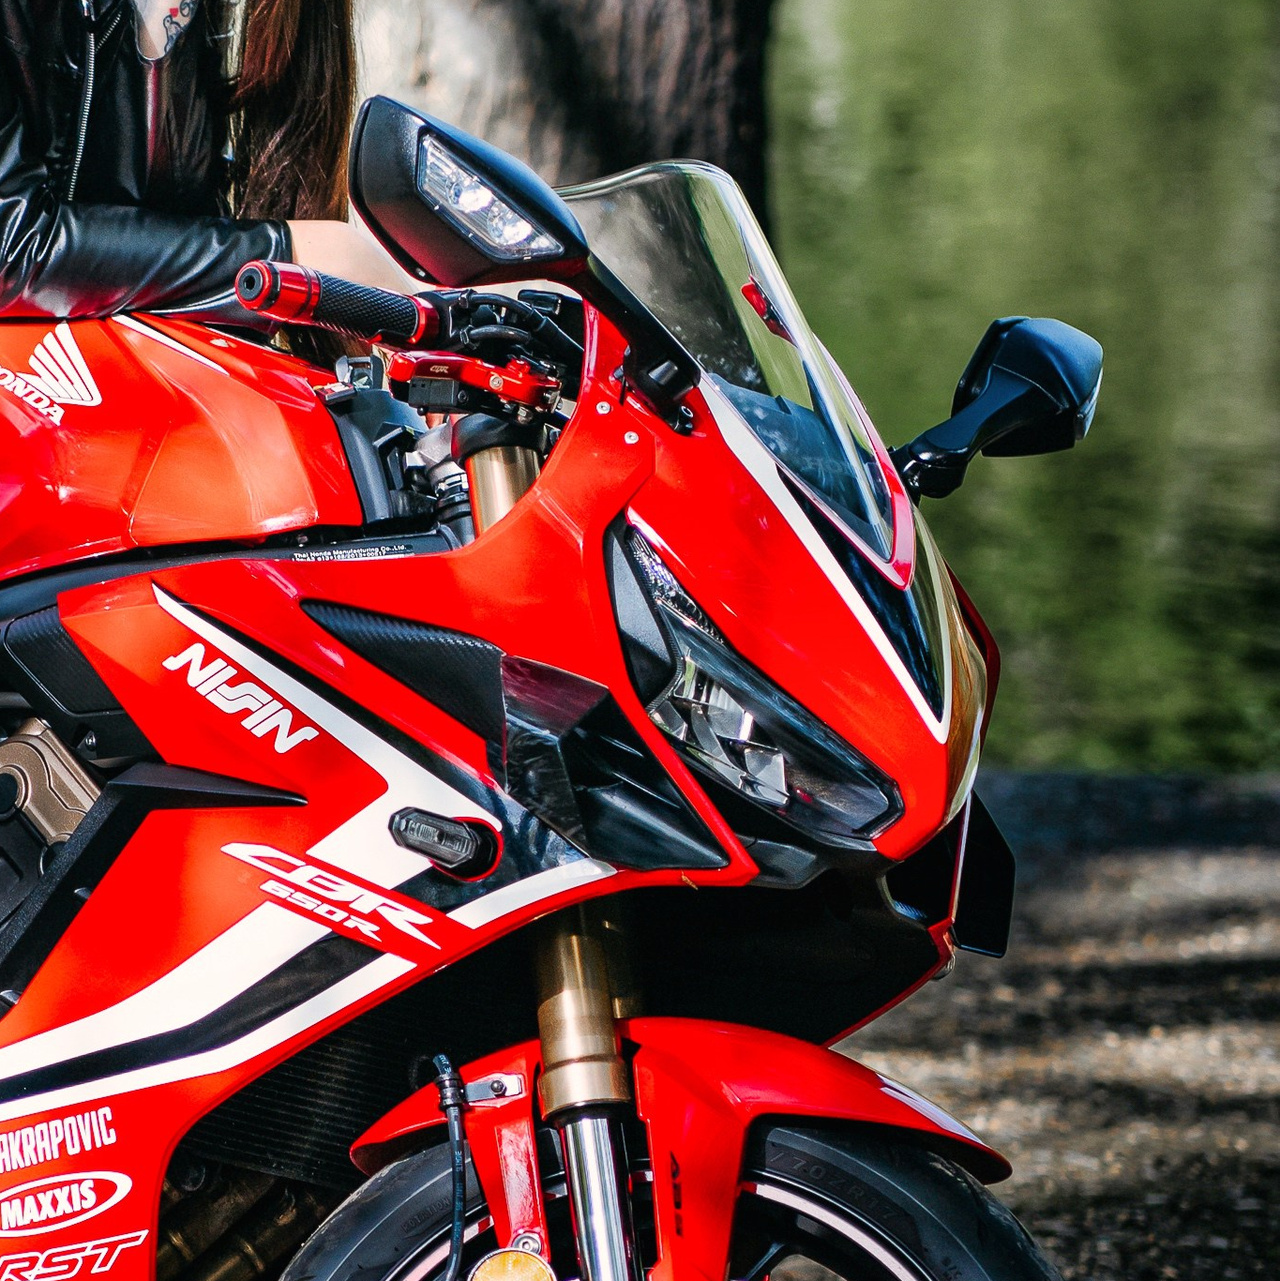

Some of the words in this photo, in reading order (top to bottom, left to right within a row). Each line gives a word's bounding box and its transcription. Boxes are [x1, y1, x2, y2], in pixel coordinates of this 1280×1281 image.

[310, 550, 332, 558] Honda
[220, 841, 442, 950] CBR
[259, 879, 382, 942] 650R
[0, 1179, 98, 1231] MAXXIS
